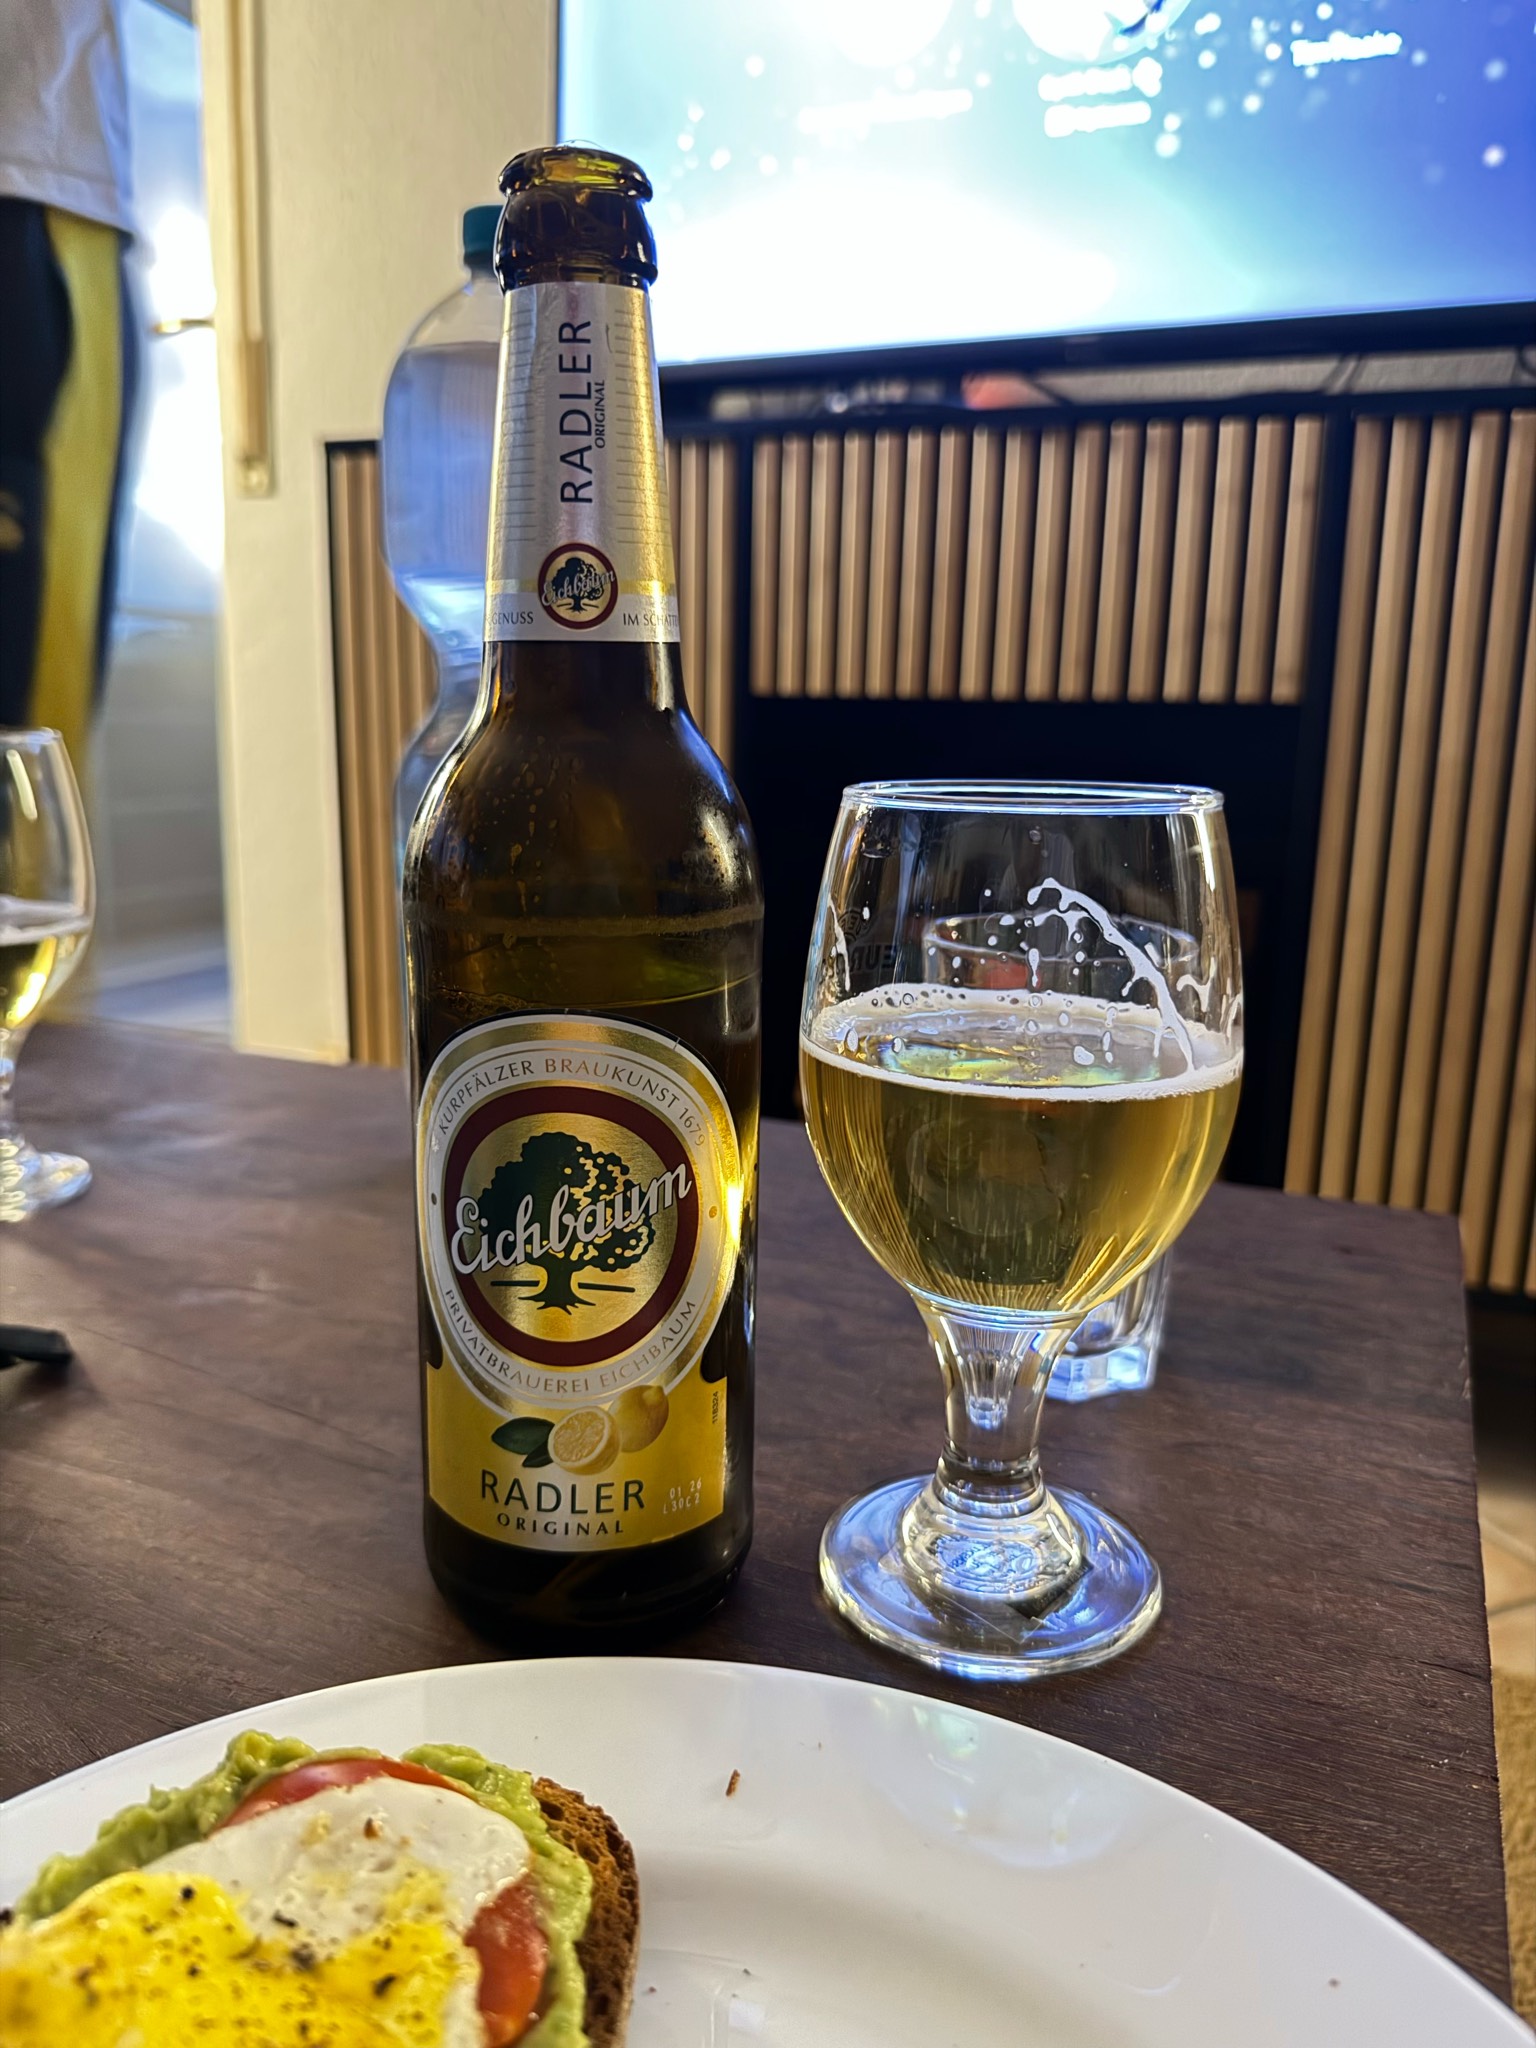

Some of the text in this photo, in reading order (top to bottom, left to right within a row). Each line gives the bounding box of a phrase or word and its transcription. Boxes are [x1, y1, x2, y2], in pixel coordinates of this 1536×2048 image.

[558, 320, 593, 503] RADLER
[594, 380, 606, 449] ORIGINAL
[541, 570, 616, 606] Eichbaum
[491, 611, 534, 625] GENUSS
[622, 612, 640, 626] IM
[438, 1058, 706, 1146] KURPFÄLZER BRAUKUNST 1679
[450, 1162, 693, 1275] Eichbaum
[445, 1289, 696, 1393] PRIVATBRAUEREI EICHBAUM
[481, 1468, 646, 1514] RADLER
[496, 1512, 624, 1536] ORIGINAL
